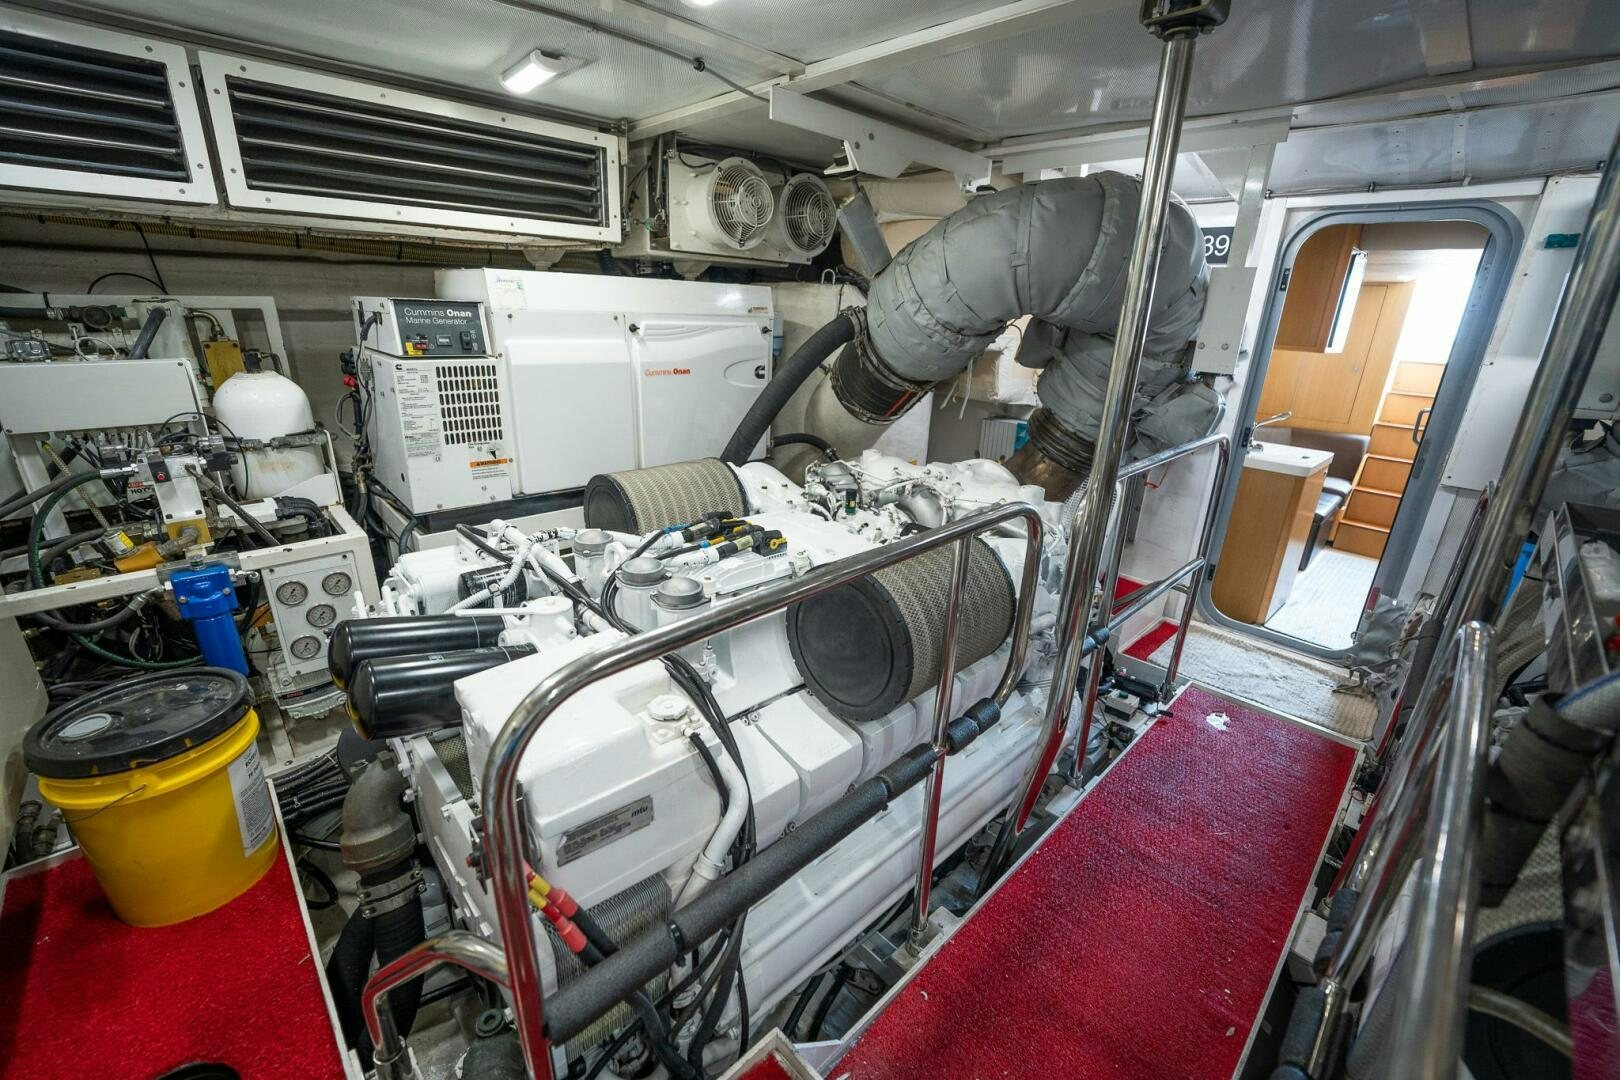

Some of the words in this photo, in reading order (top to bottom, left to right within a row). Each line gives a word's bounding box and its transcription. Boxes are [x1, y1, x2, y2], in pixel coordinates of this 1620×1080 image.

[404, 307, 445, 316] Cummins
[446, 308, 472, 317] Onan
[432, 317, 467, 325] Generator
[631, 805, 648, 818] mtu
